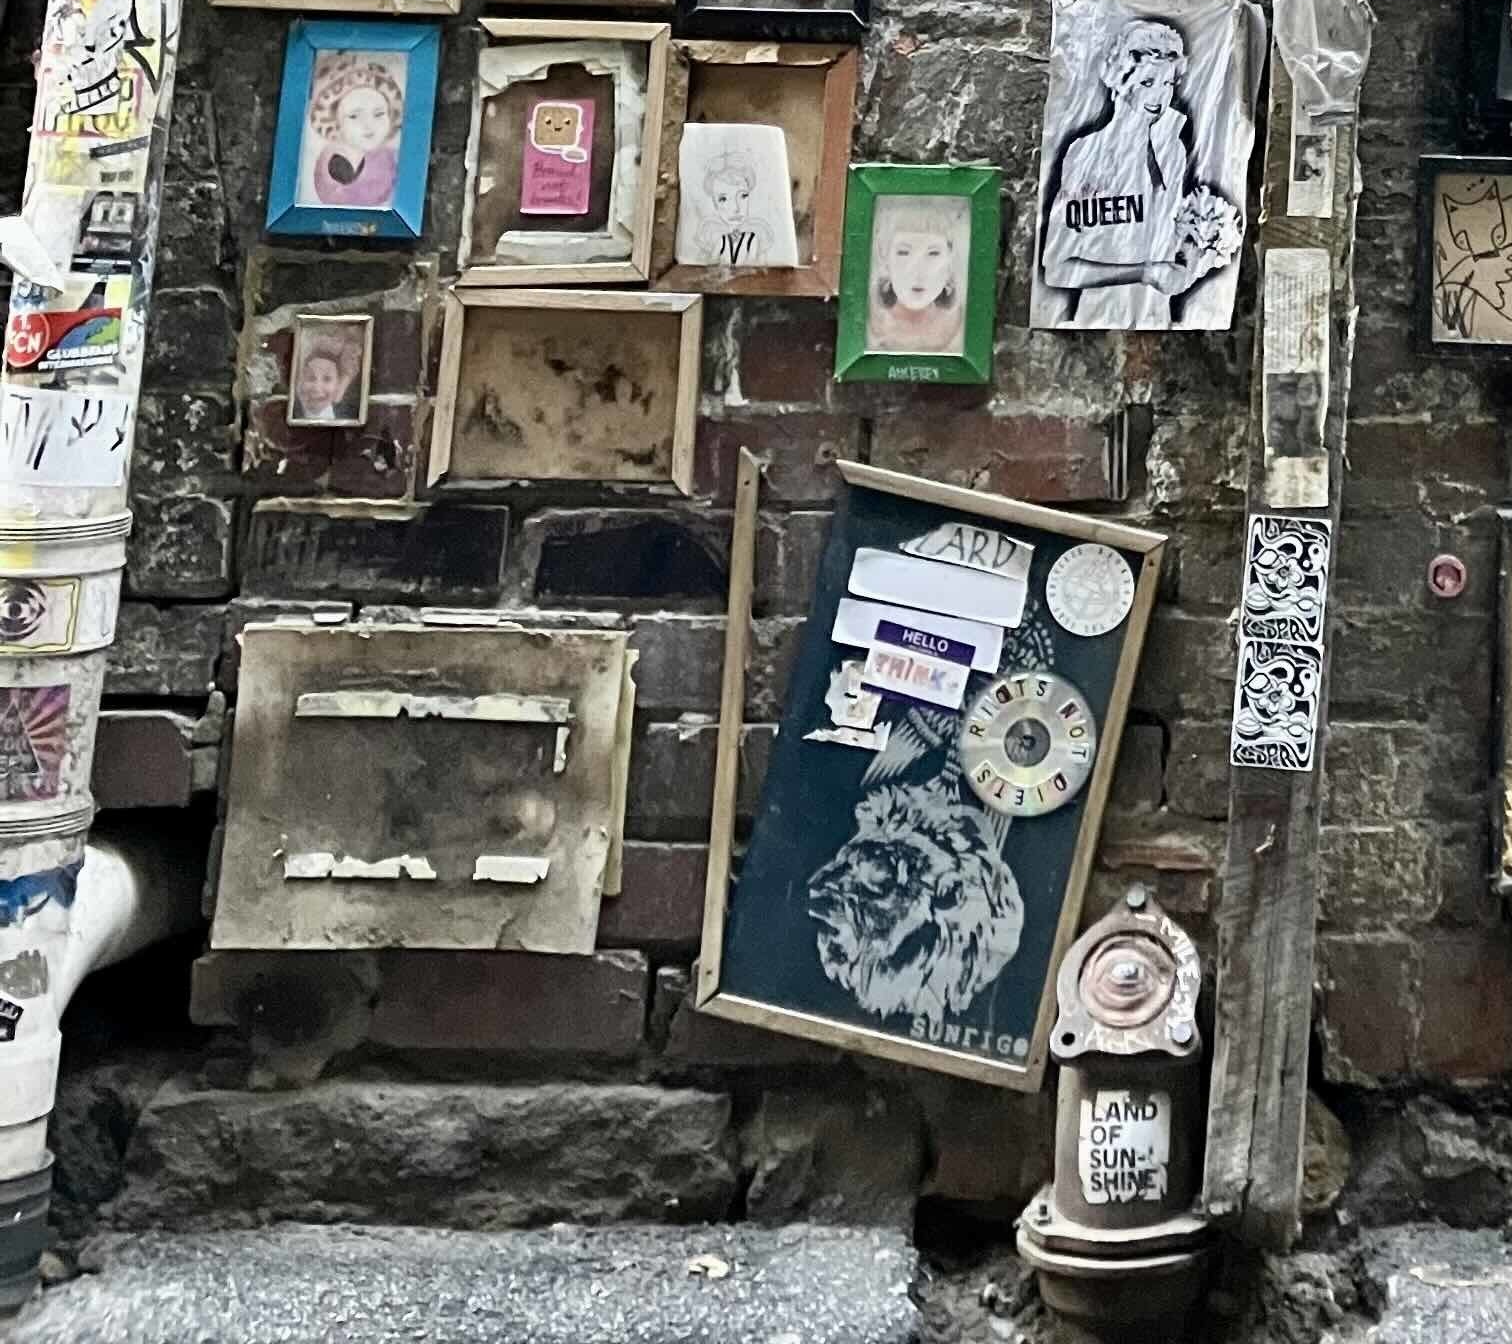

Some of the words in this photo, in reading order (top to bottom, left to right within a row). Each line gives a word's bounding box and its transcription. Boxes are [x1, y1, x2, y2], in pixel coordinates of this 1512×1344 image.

[1065, 193, 1144, 233] QUEEN
[902, 629, 949, 654] HELLO
[1090, 1101, 1159, 1123] LAND
[1090, 1125, 1123, 1146] OF
[1089, 1169, 1159, 1192] SHINE
